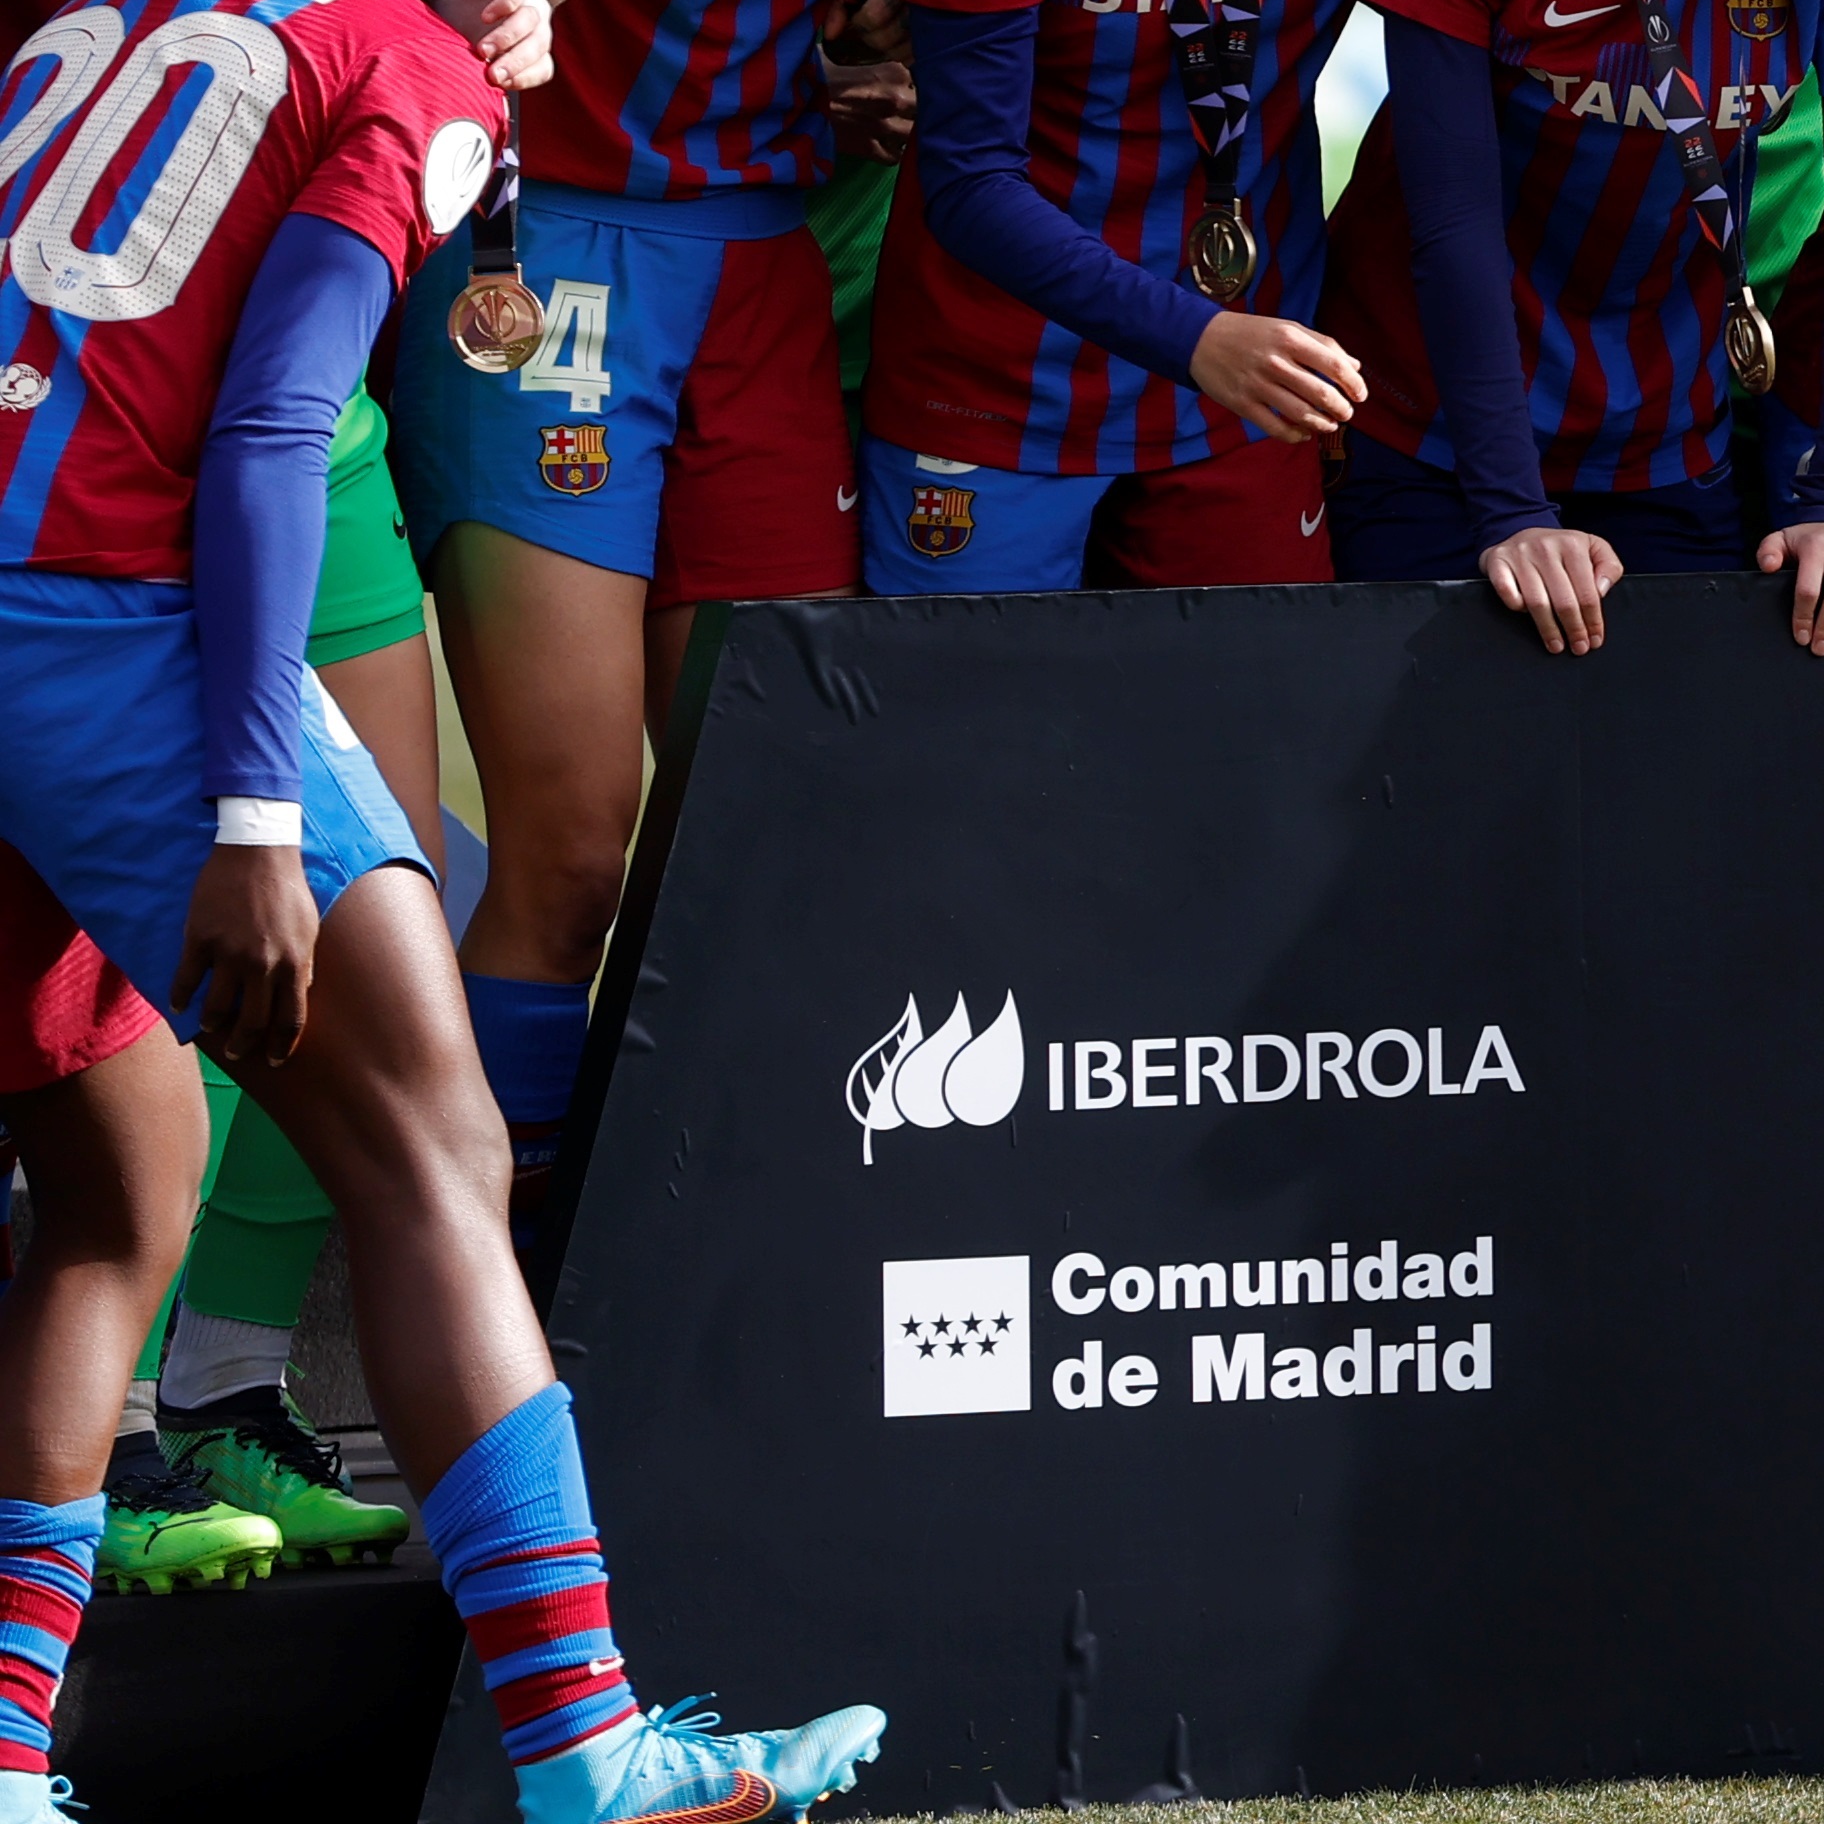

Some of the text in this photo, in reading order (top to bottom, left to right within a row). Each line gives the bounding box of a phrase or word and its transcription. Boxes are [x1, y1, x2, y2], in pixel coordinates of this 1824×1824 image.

[1524, 67, 1801, 131] TANEY
[520, 278, 610, 413] 4
[562, 453, 588, 463] FCB
[926, 516, 953, 526] FCB
[1049, 1025, 1525, 1111] IBERDROLA
[1051, 1235, 1494, 1316] Comunidad
[1052, 1323, 1492, 1410] de Madrid
